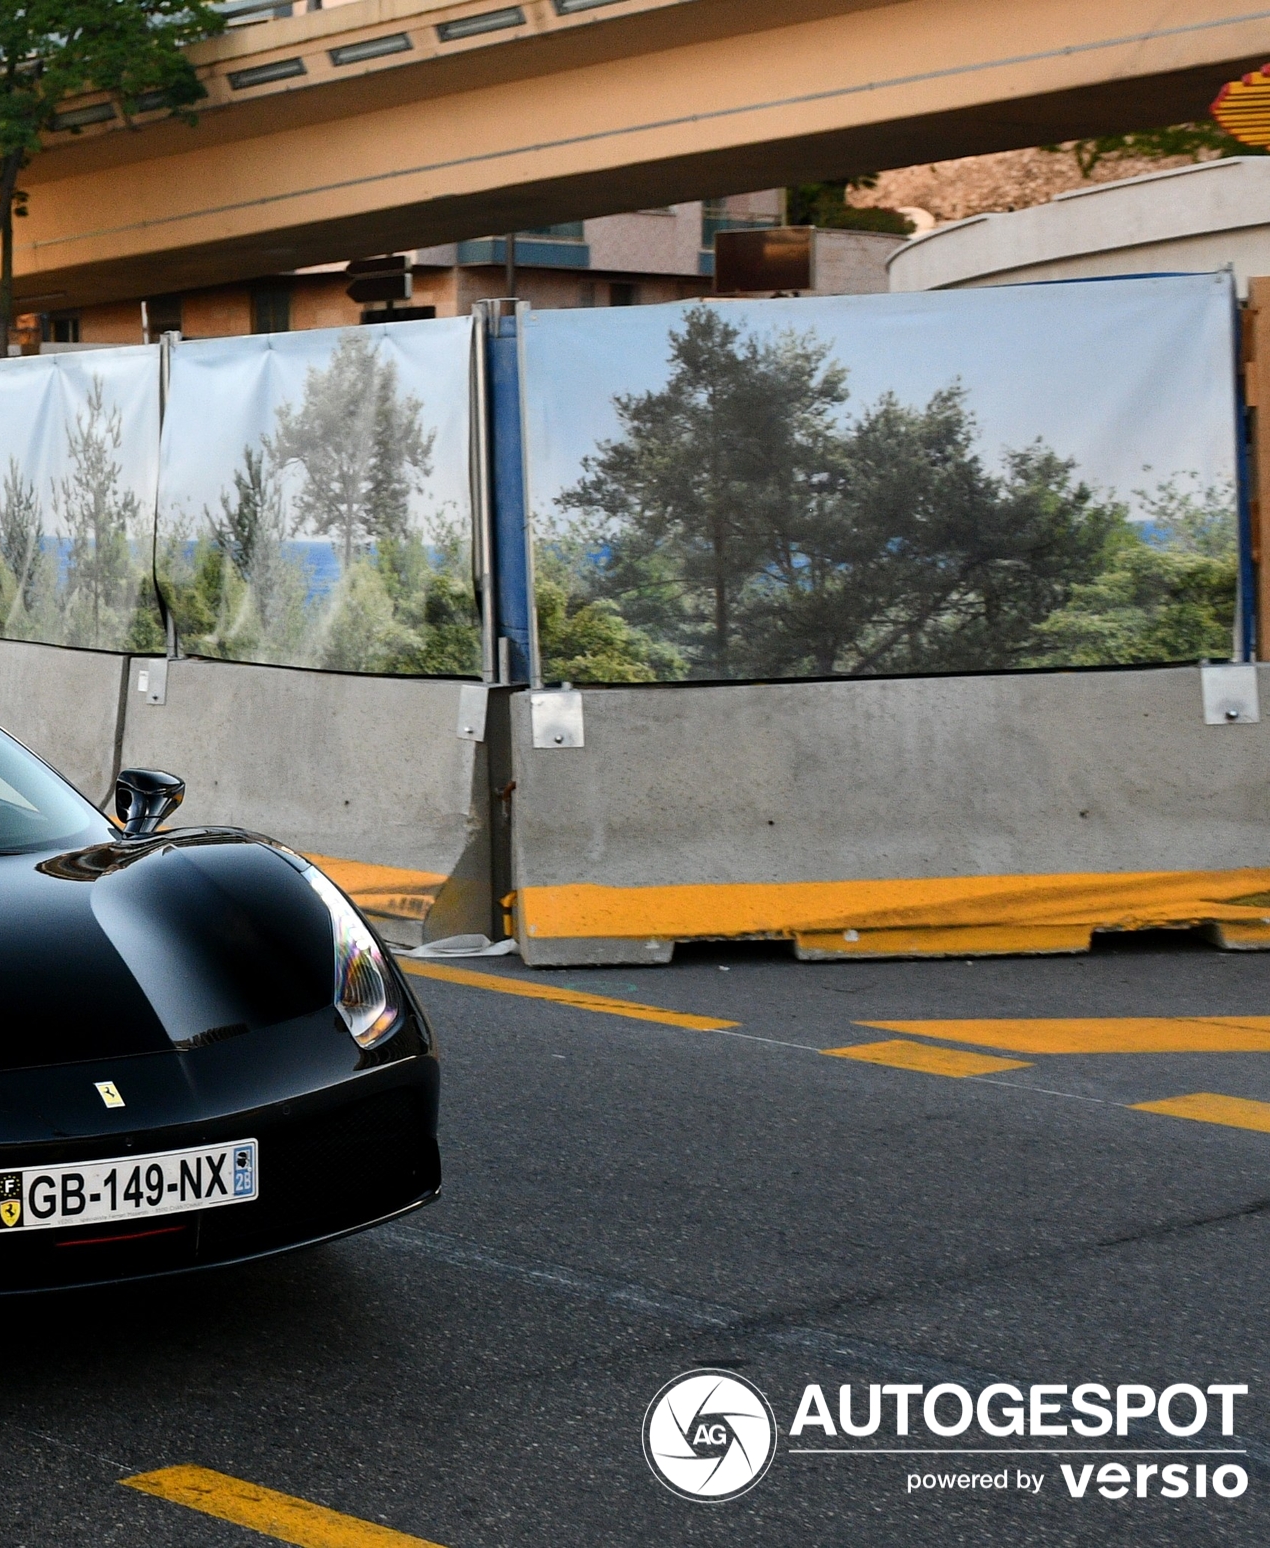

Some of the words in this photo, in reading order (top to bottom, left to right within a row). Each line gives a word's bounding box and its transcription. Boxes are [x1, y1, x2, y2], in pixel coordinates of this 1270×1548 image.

[4, 1179, 15, 1193] F
[29, 1152, 228, 1219] GB-149-NX
[235, 1171, 252, 1192] 2B
